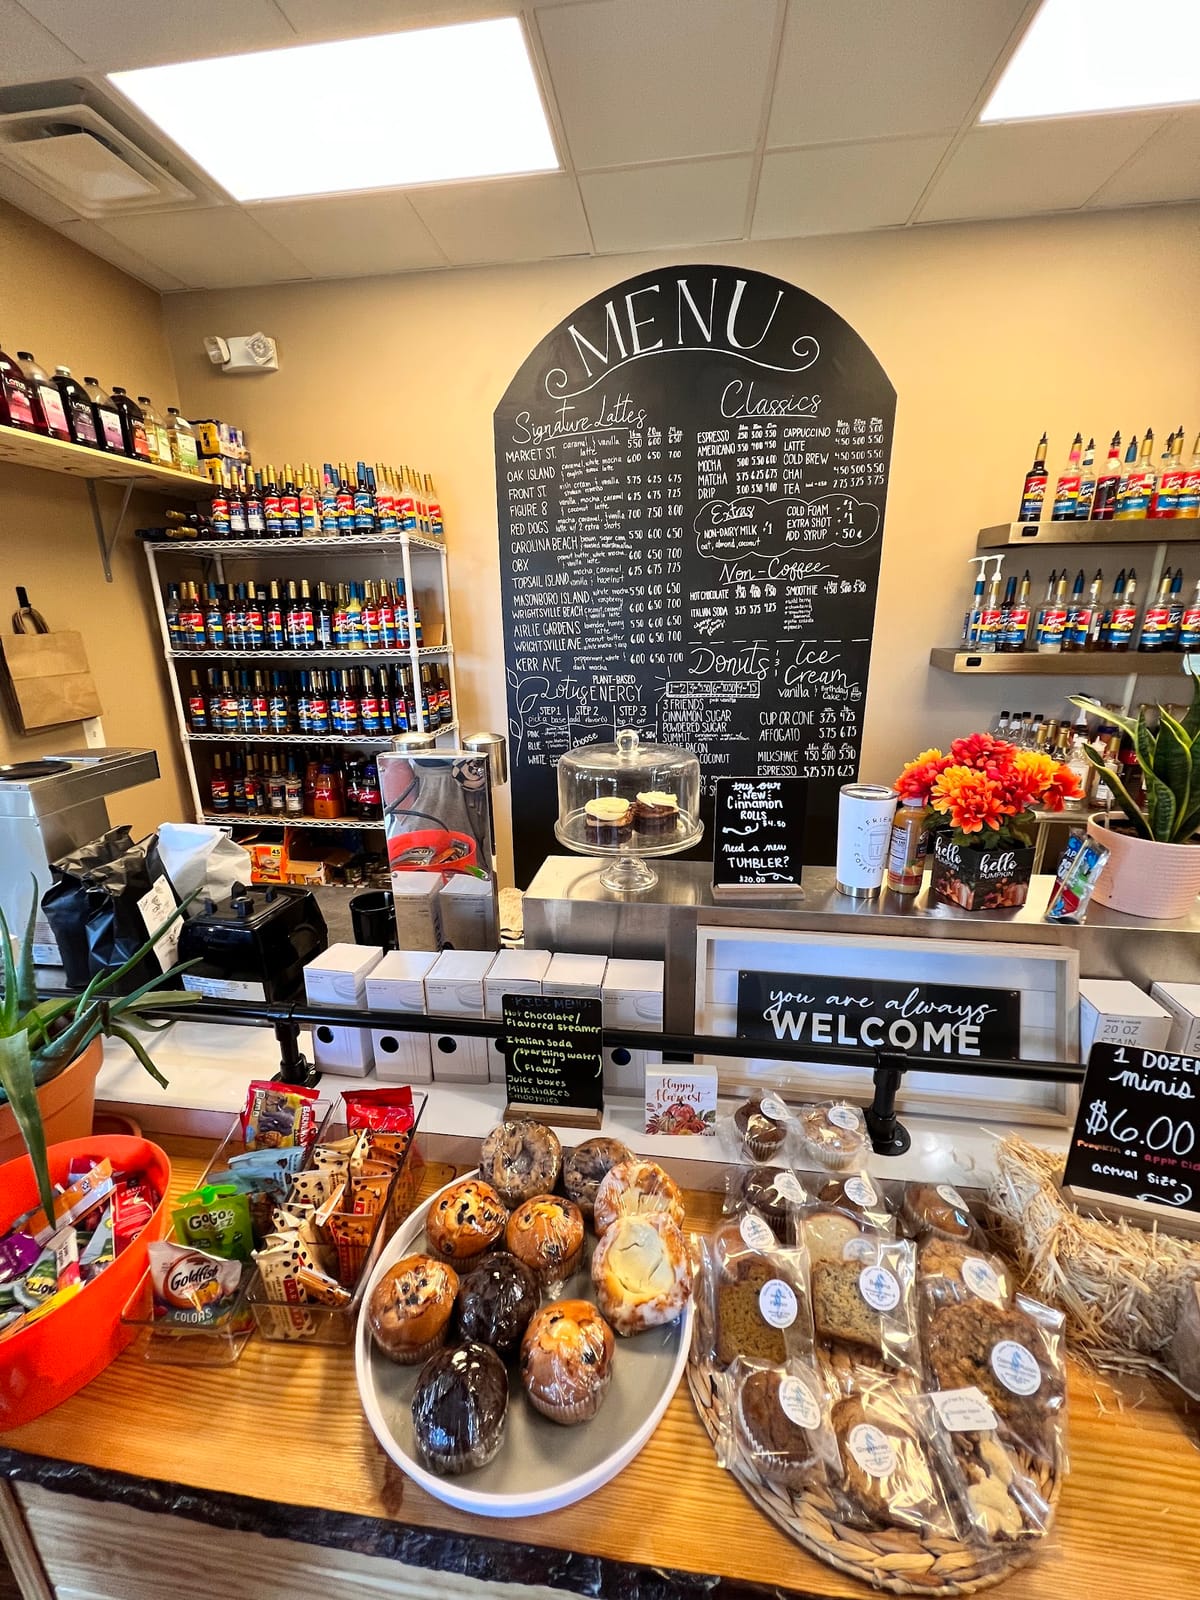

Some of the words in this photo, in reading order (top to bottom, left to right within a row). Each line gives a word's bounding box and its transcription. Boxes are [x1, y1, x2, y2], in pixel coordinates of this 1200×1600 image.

[568, 279, 784, 377] MENU
[720, 379, 822, 418] Classics
[512, 399, 592, 445] Signature
[595, 393, 648, 429] Lattes
[697, 430, 730, 444] ESPRESSO
[783, 427, 832, 438] CAPPUCCINO
[563, 437, 588, 449] caramel
[598, 435, 621, 446] vanilla
[783, 440, 805, 451] LATTE
[505, 448, 542, 463] MARKET
[546, 446, 557, 459] ST.
[580, 448, 597, 456] latte
[697, 443, 736, 457] AMERICANO
[698, 459, 722, 472] MOCHA
[783, 455, 803, 465] COLD
[805, 453, 830, 464] BREW
[507, 468, 524, 482] OAK
[527, 465, 556, 481] ISLAND
[698, 472, 728, 487] MATCHA
[783, 469, 803, 480] CHAI
[508, 485, 535, 501] FRONT
[698, 488, 716, 500] DRIP
[783, 483, 800, 495] TEA
[510, 503, 538, 517] FIGURE
[541, 501, 548, 516] 8
[711, 504, 756, 525] Extras
[786, 506, 805, 516] COLD
[807, 504, 829, 516] FOAM
[510, 522, 525, 536] RED
[527, 520, 549, 535] DOGS
[786, 518, 810, 529] EXTRA
[811, 516, 833, 528] SHOT
[739, 524, 758, 536] MILK
[785, 530, 800, 541] ADD
[803, 528, 828, 541] SYRUP
[511, 539, 550, 554] CAROLINA
[552, 537, 578, 551] BEACH
[512, 559, 529, 573] OBX
[512, 576, 543, 590] TOPSAIL
[545, 573, 570, 587] ISLAND
[689, 591, 700, 601] HOT
[785, 585, 819, 597] SMOOTHIE
[513, 593, 558, 607] MASONBORO
[560, 591, 590, 605] ISLAND
[512, 606, 561, 619] WRIGHTSVILLE
[563, 605, 584, 617] BEACH
[712, 606, 729, 617] SODA
[514, 623, 541, 638] AIRLIE
[543, 621, 582, 635] GARDENS
[514, 639, 565, 653] WRIGHTSVILLE
[515, 658, 539, 673] KERR
[542, 656, 562, 673] AVE
[688, 642, 771, 681] Donuts
[795, 642, 841, 666] Ice
[592, 674, 636, 685] PLANT-BASED
[784, 664, 860, 686] Cream
[590, 685, 645, 703] ENERGY
[778, 684, 810, 699] vanilla
[820, 685, 849, 699] Birthday
[822, 692, 841, 700] Cake
[575, 706, 591, 716] STEP
[592, 706, 599, 715] 2
[619, 706, 638, 716] STEP
[639, 705, 648, 716] 3
[662, 700, 669, 710] 3
[670, 698, 705, 711] FRIENDS
[539, 707, 557, 716] STEP
[662, 710, 703, 722] CINNAMON
[705, 709, 732, 722] SUGAR
[759, 711, 777, 725] CUP
[778, 711, 791, 725] OR
[792, 711, 815, 725] CONE
[528, 714, 541, 724] pick
[550, 716, 567, 724] base
[662, 722, 700, 733] POWDERED
[701, 722, 727, 733] SUGAR
[527, 731, 540, 739] PINK
[572, 732, 599, 748] choose
[662, 732, 691, 743] SUMMIT
[758, 728, 801, 741] AFFOGATO
[527, 742, 541, 751] BLUE
[527, 755, 547, 765] WHITE
[700, 753, 731, 765] COCONUT
[757, 750, 799, 762] MILKSHAKE
[757, 765, 797, 776] ESPRESSO
[727, 795, 784, 809] Cinnamon
[740, 810, 767, 820] ROLLS
[762, 820, 786, 828] $4.50
[763, 843, 787, 852] new
[935, 836, 962, 865] hello
[727, 855, 790, 868] TUMBLER?
[935, 853, 960, 872] PUMPKIN
[979, 851, 1019, 874] hello
[739, 874, 766, 883] $20.00
[979, 870, 1014, 880] PUMPKIN
[763, 989, 816, 1022] you
[826, 994, 874, 1009] are
[884, 986, 998, 1038] always
[506, 1018, 554, 1031] Flavored
[1103, 1024, 1119, 1034] 20
[1122, 1025, 1140, 1036] OZ
[769, 1009, 981, 1057] WELCOME
[505, 1035, 545, 1046] Italian
[547, 1038, 573, 1048] Soda
[1113, 1047, 1130, 1064] 1
[507, 1074, 533, 1084] Juice
[536, 1077, 567, 1088] boxes
[662, 1077, 696, 1093] Happy
[1108, 1069, 1195, 1099] minis
[508, 1084, 570, 1097] Milkshakes
[656, 1088, 710, 1103] Harvest
[1085, 1099, 1195, 1156] $6.00
[1144, 1153, 1177, 1166] apple
[1091, 1162, 1138, 1181] actual
[170, 1264, 219, 1291] Goldfish
[174, 1308, 213, 1323] COLORS
